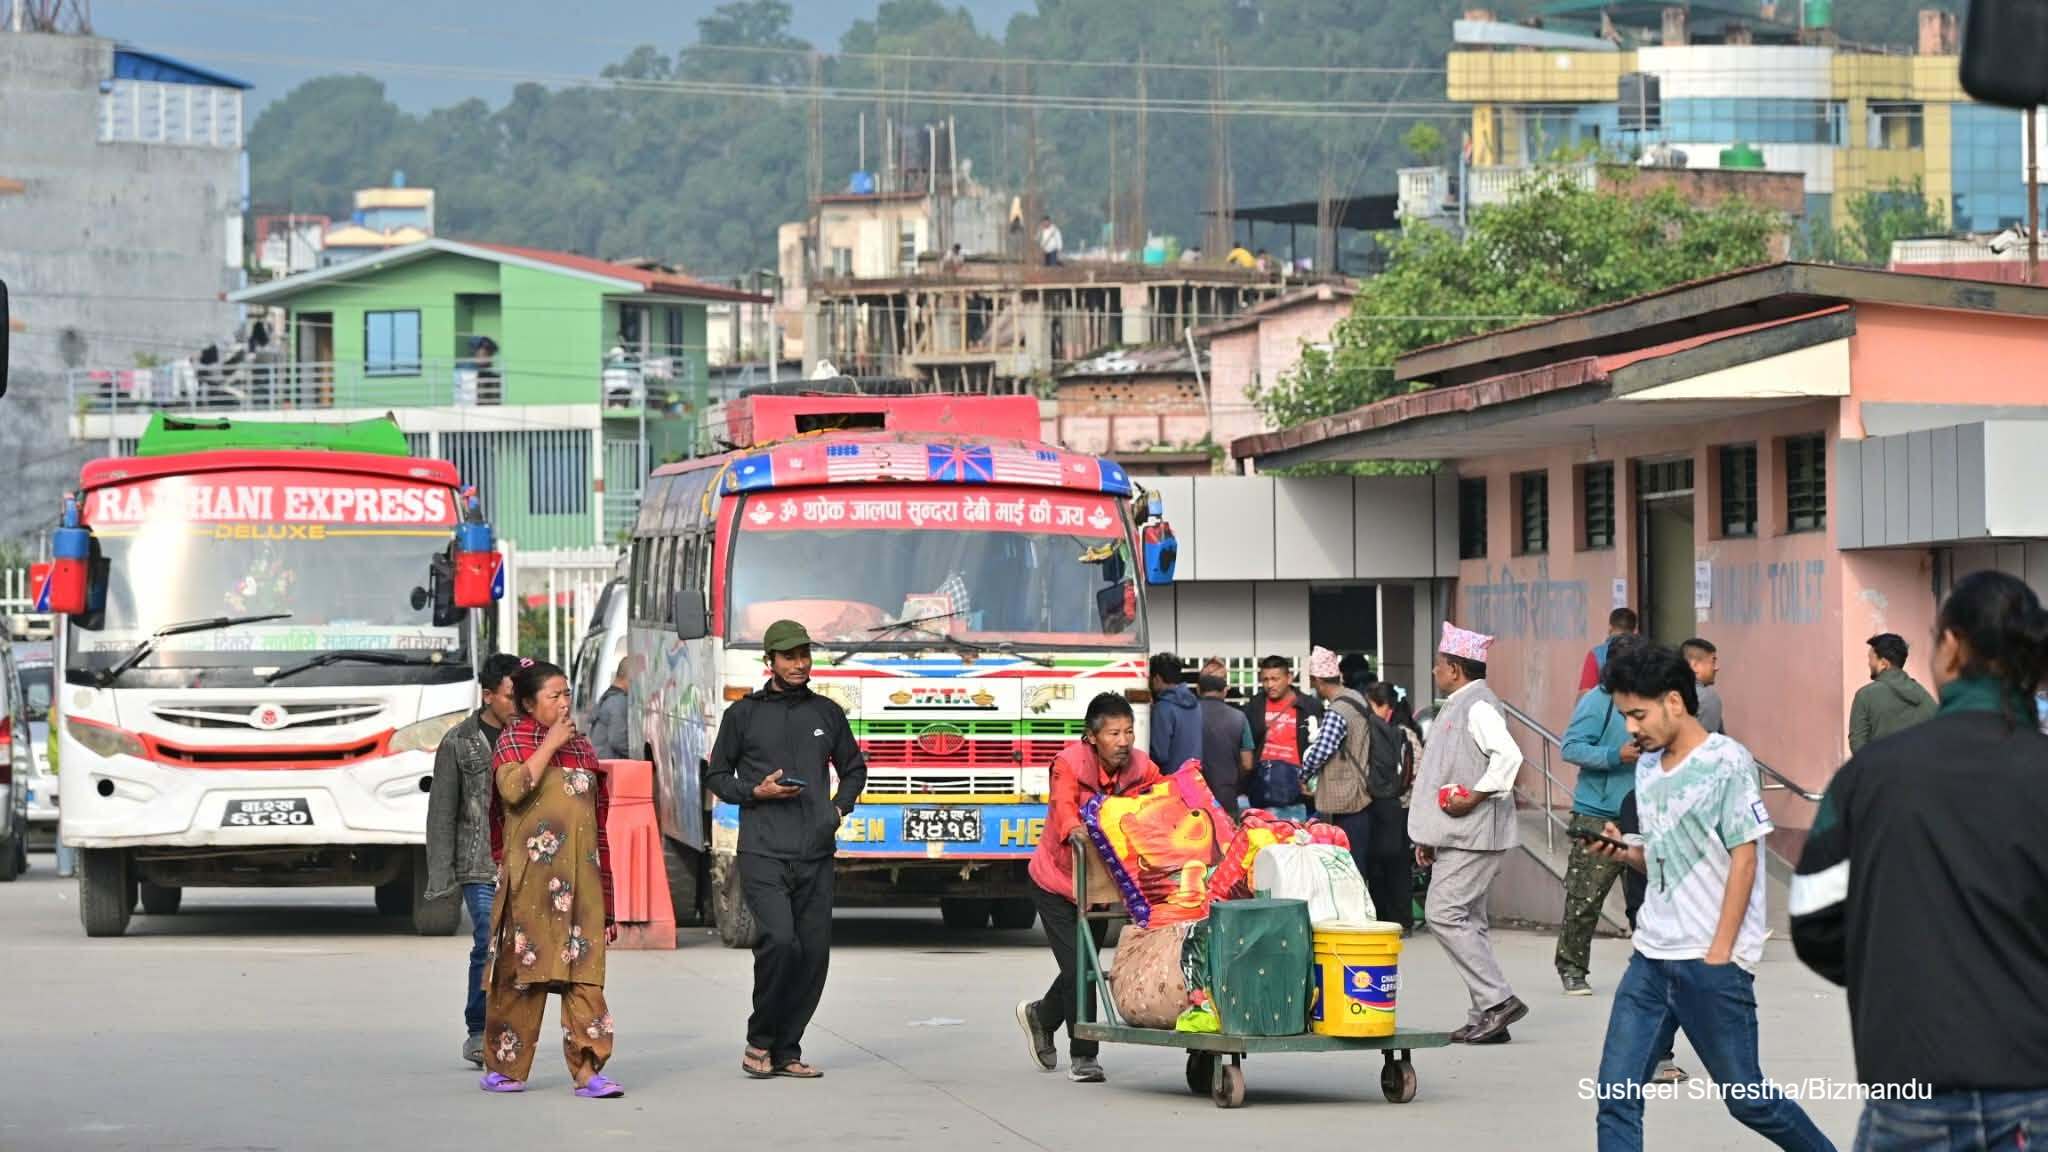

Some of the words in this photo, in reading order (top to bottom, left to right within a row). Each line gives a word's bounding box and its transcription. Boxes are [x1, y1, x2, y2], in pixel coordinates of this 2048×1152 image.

[284, 487, 446, 522] EXPRESS
[849, 501, 902, 521] जालपा
[995, 499, 1024, 525] माई
[1028, 498, 1052, 524] की
[1056, 505, 1085, 526] जय
[215, 523, 326, 540] DELUXE
[911, 687, 971, 704] TATA
